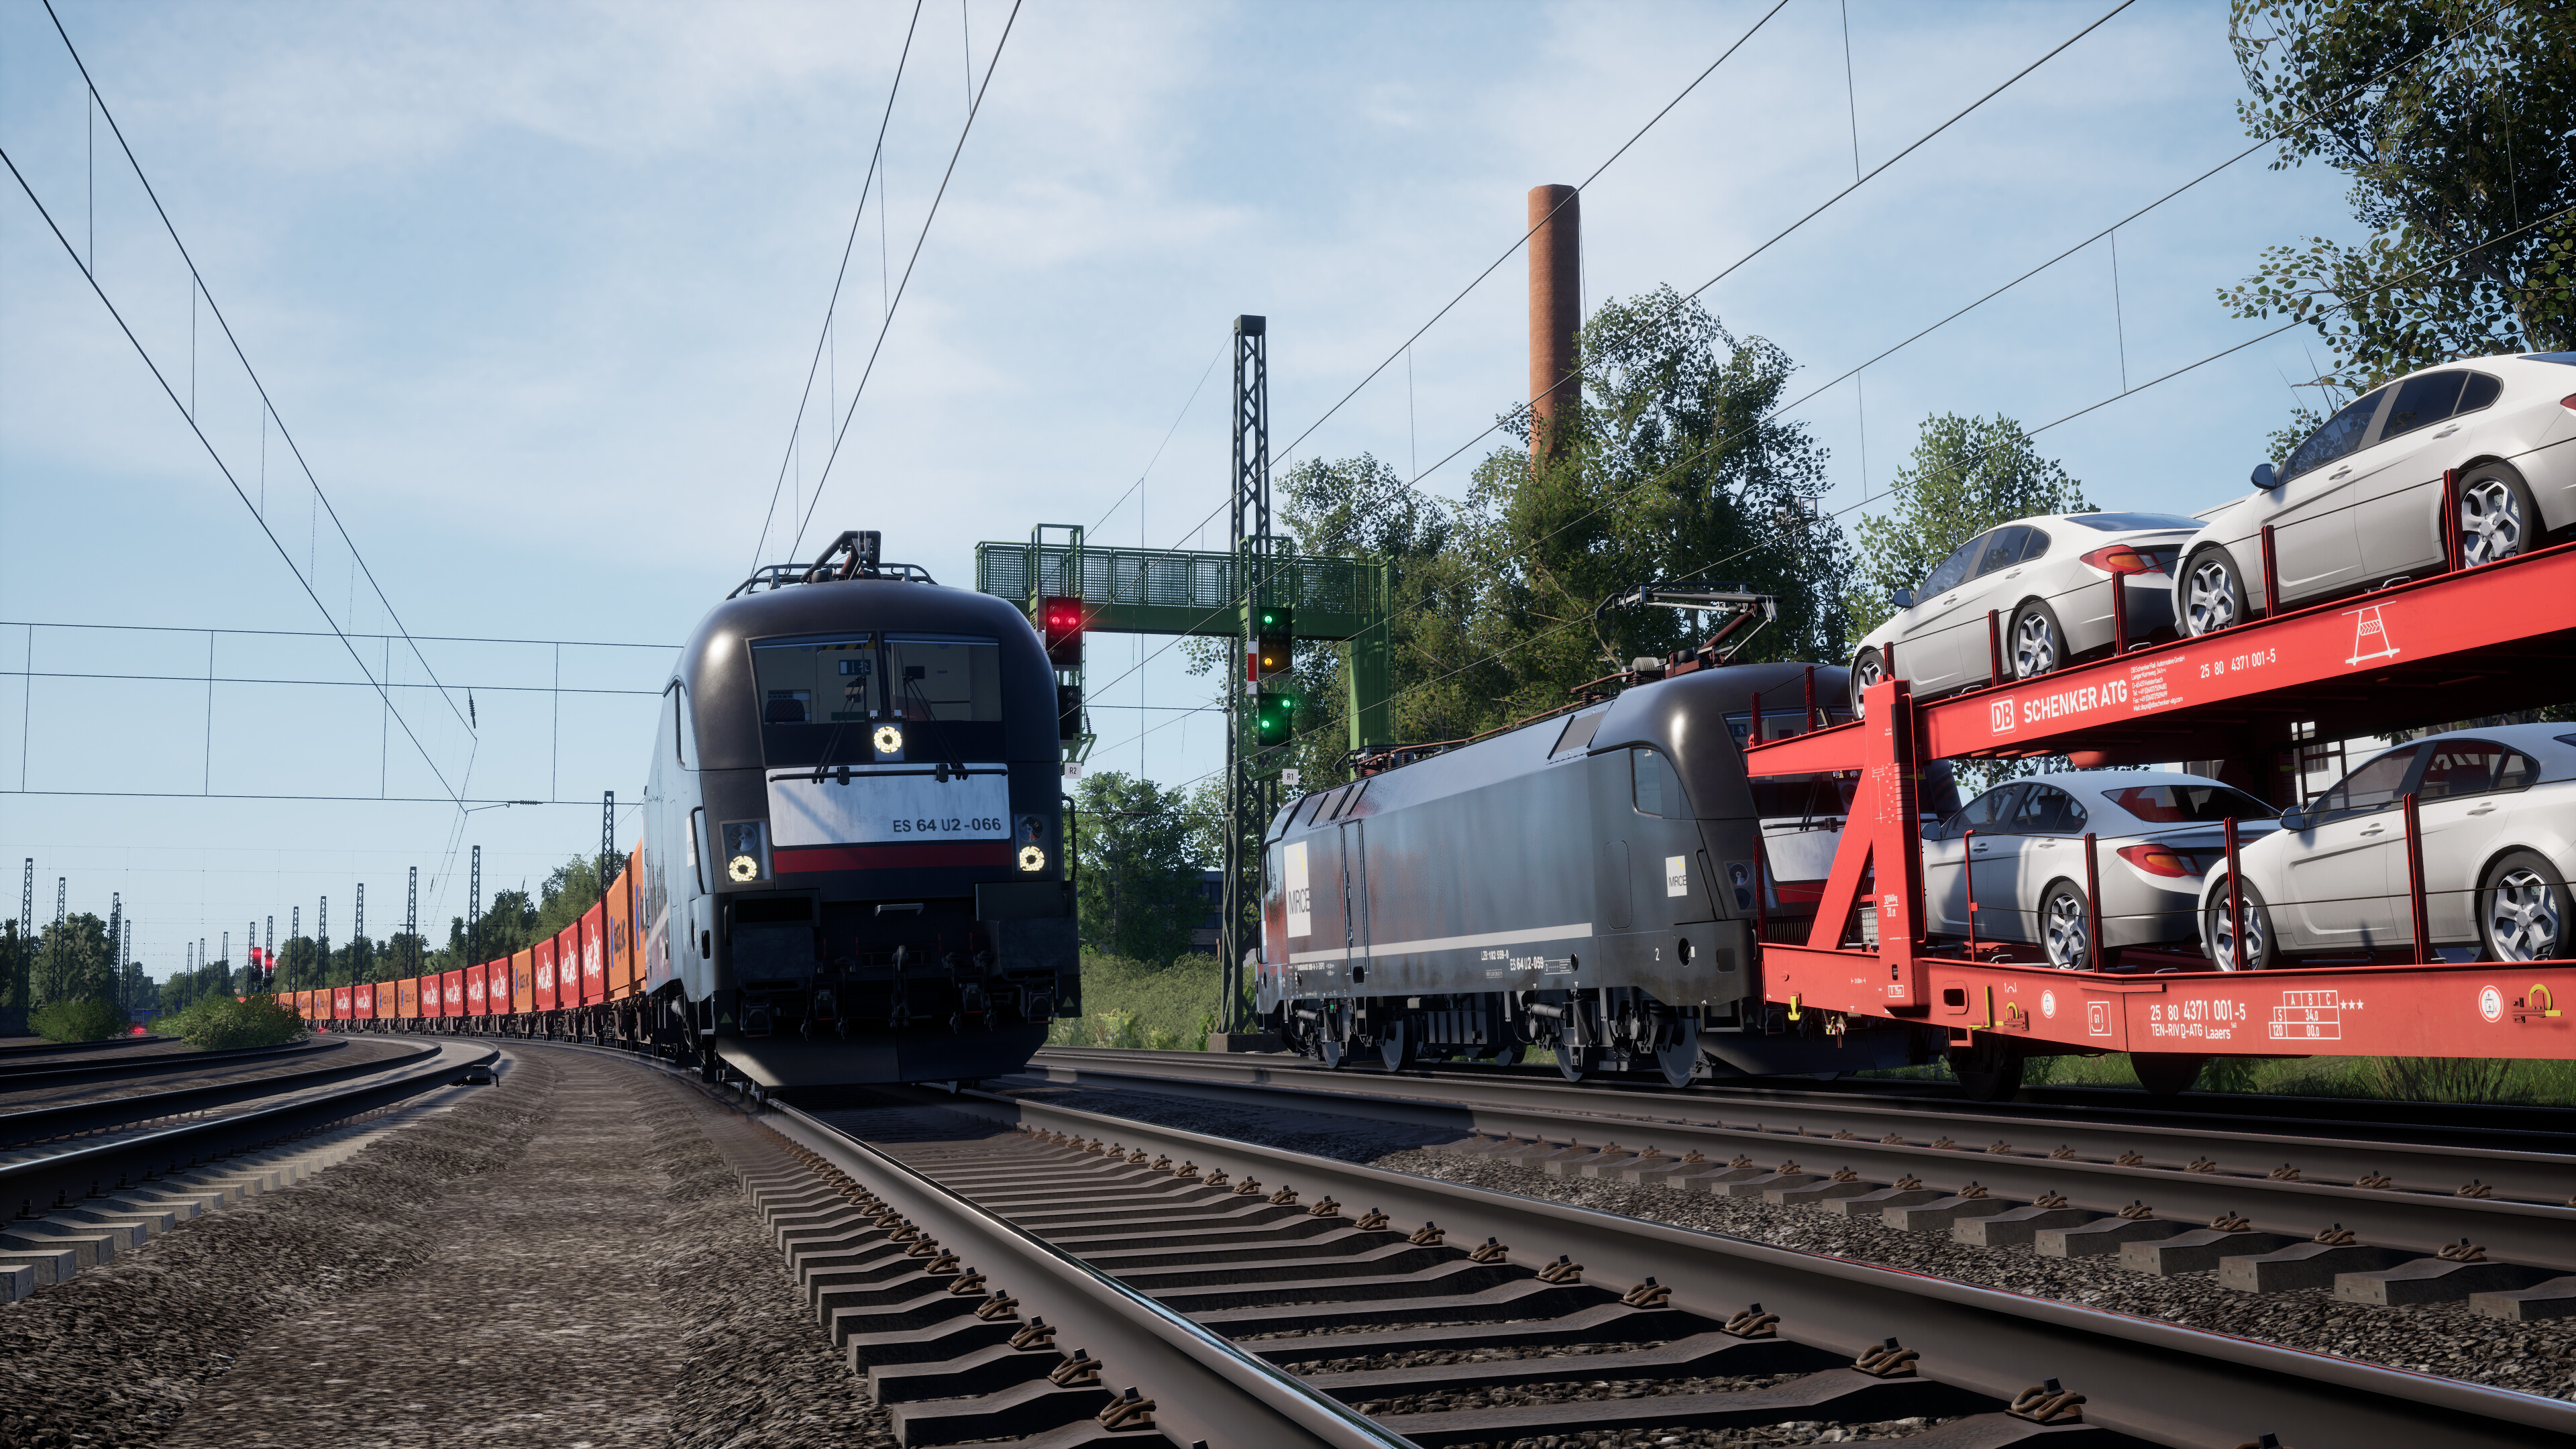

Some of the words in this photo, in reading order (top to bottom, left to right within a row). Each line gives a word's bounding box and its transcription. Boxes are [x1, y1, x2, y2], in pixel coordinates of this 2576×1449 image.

[2174, 655, 2185, 663] GmbH
[2200, 663, 2210, 678] 25
[2214, 661, 2224, 676] 80
[2231, 655, 2249, 671] 4371
[2251, 648, 2275, 667] 001-5
[1992, 700, 2015, 732] DB
[2024, 686, 2098, 723] SCHENKER
[2100, 680, 2127, 706] ATG
[893, 820, 912, 833] ES
[916, 819, 936, 832] 64
[1668, 875, 1687, 888] MRCE
[1289, 888, 1310, 915] MRCE
[1489, 950, 1497, 960] 182
[1497, 949, 1509, 960] 559-0
[1655, 947, 1660, 961] 2
[1509, 958, 1516, 971] ES
[1516, 957, 1524, 970] 64
[2291, 994, 2296, 1006] A
[2308, 993, 2313, 1006] B
[2326, 993, 2330, 1006] C
[2150, 1005, 2161, 1020] 25
[2167, 1004, 2179, 1020] 80
[2184, 1000, 2208, 1020] 4371
[2214, 1000, 2246, 1020] 001-5
[2277, 1009, 2282, 1022] S
[2094, 1014, 2100, 1024] G1
[2151, 1024, 2180, 1036] TEN-RIV
[2180, 1024, 2203, 1038] D-ATG
[2205, 1025, 2231, 1039] Laaers
[2273, 1024, 2283, 1036] 120
